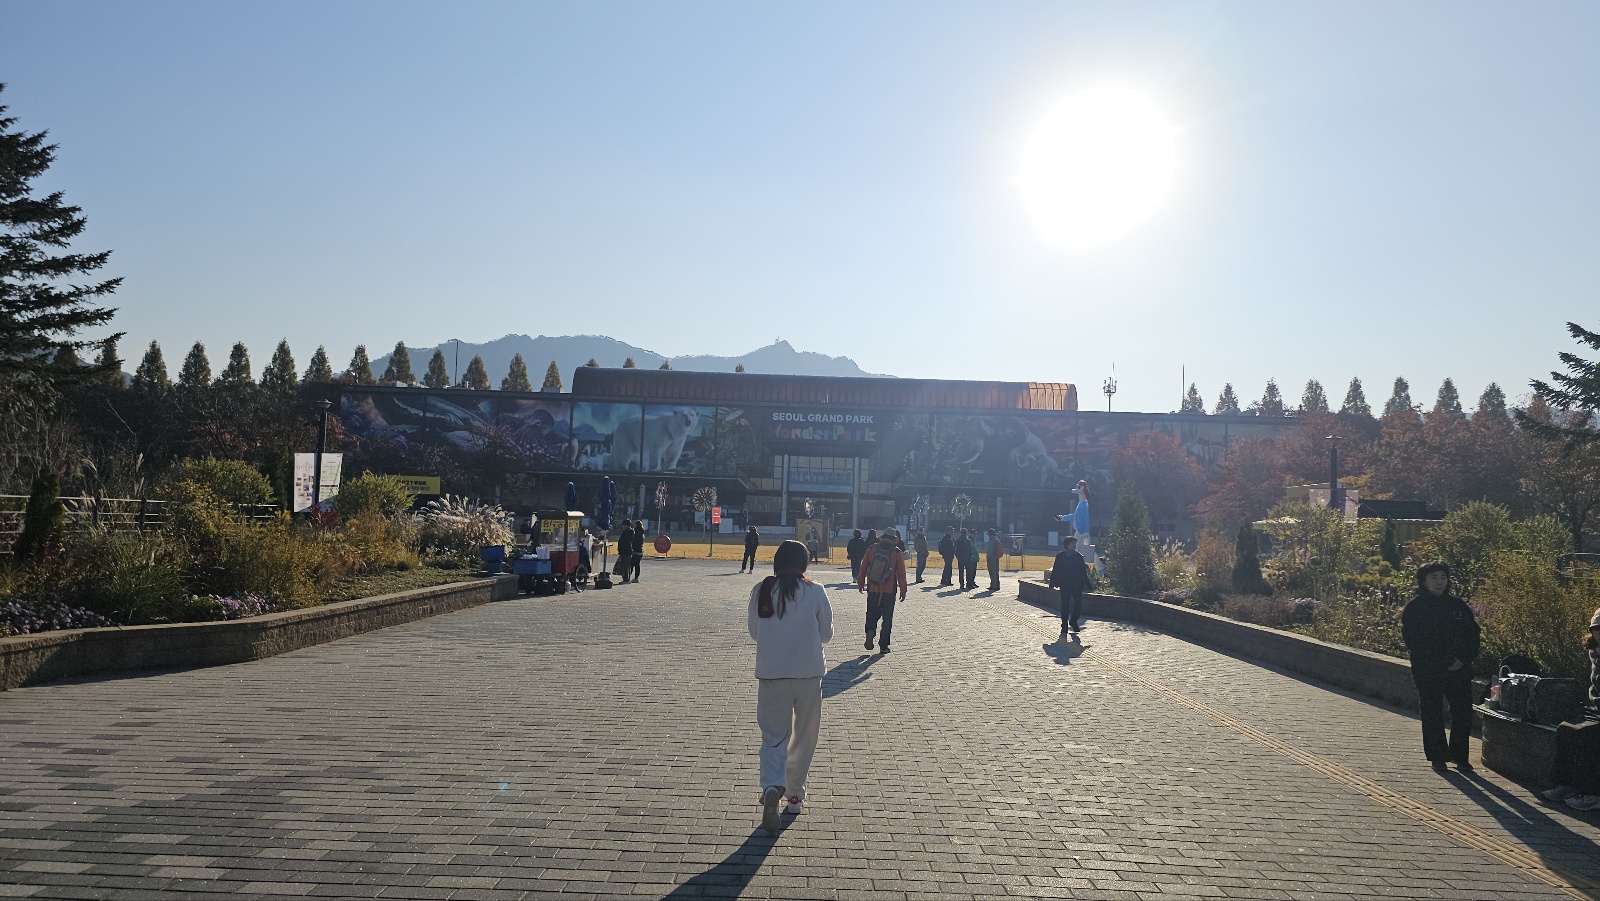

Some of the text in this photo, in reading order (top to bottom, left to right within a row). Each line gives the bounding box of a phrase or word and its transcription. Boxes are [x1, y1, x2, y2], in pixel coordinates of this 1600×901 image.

[772, 412, 874, 424] SEOUL GRAND PARK
